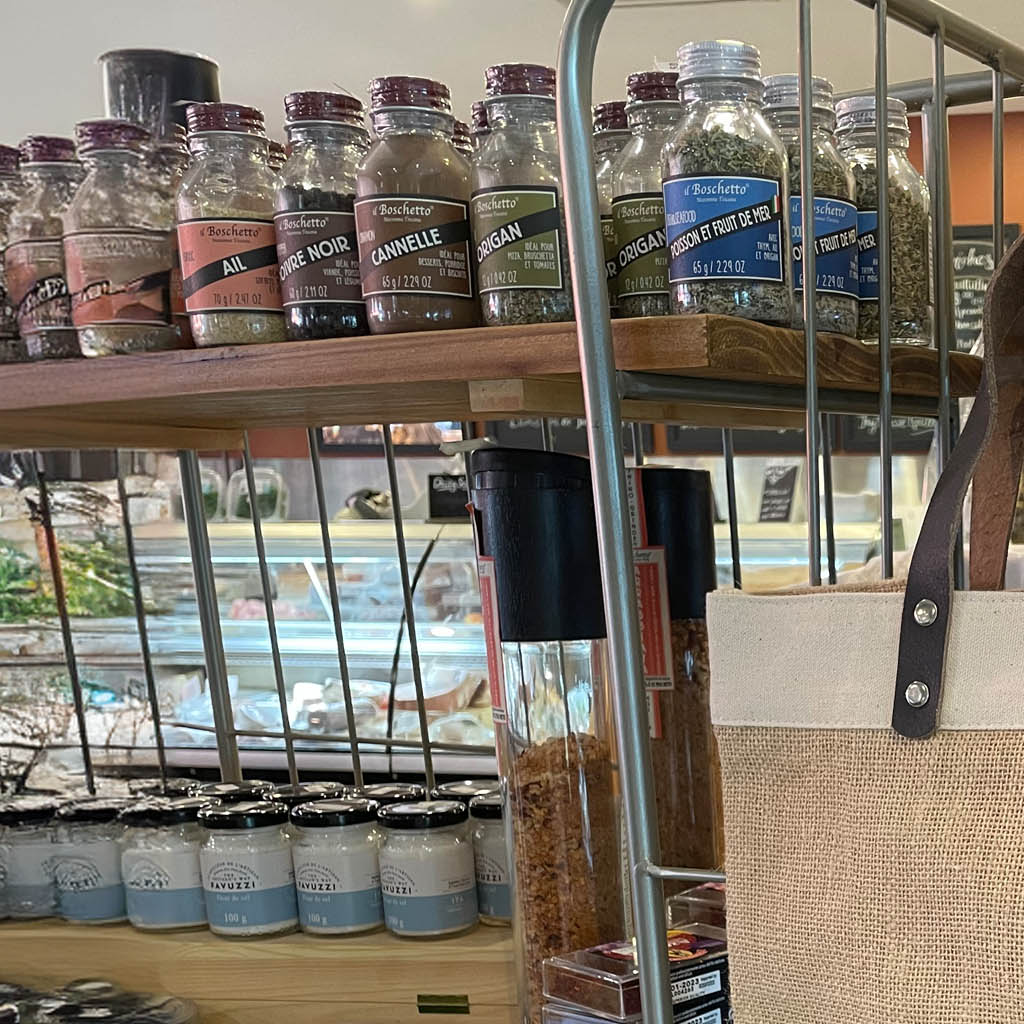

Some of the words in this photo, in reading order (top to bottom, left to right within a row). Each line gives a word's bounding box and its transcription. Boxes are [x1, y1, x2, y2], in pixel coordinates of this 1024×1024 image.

[692, 180, 747, 195] Boschetto
[379, 202, 431, 215] Boschetto
[477, 197, 517, 213] Boschetto
[814, 202, 846, 217] schetto
[207, 224, 260, 238] Boschetto
[283, 215, 327, 230] Boschetto
[671, 229, 701, 259] POISSON
[701, 224, 712, 241] ET
[712, 215, 739, 236] FRUIT
[738, 210, 753, 228] DE
[753, 205, 771, 224] MER
[307, 236, 351, 262] NOIR
[372, 228, 442, 266] CANNELLE
[477, 222, 522, 262] ORIGAN
[619, 228, 666, 267] ORIGAN
[820, 234, 840, 253] FRUIT
[858, 233, 876, 251] MER
[223, 256, 248, 276] AIL
[693, 260, 702, 273] 65
[382, 275, 390, 288] 65
